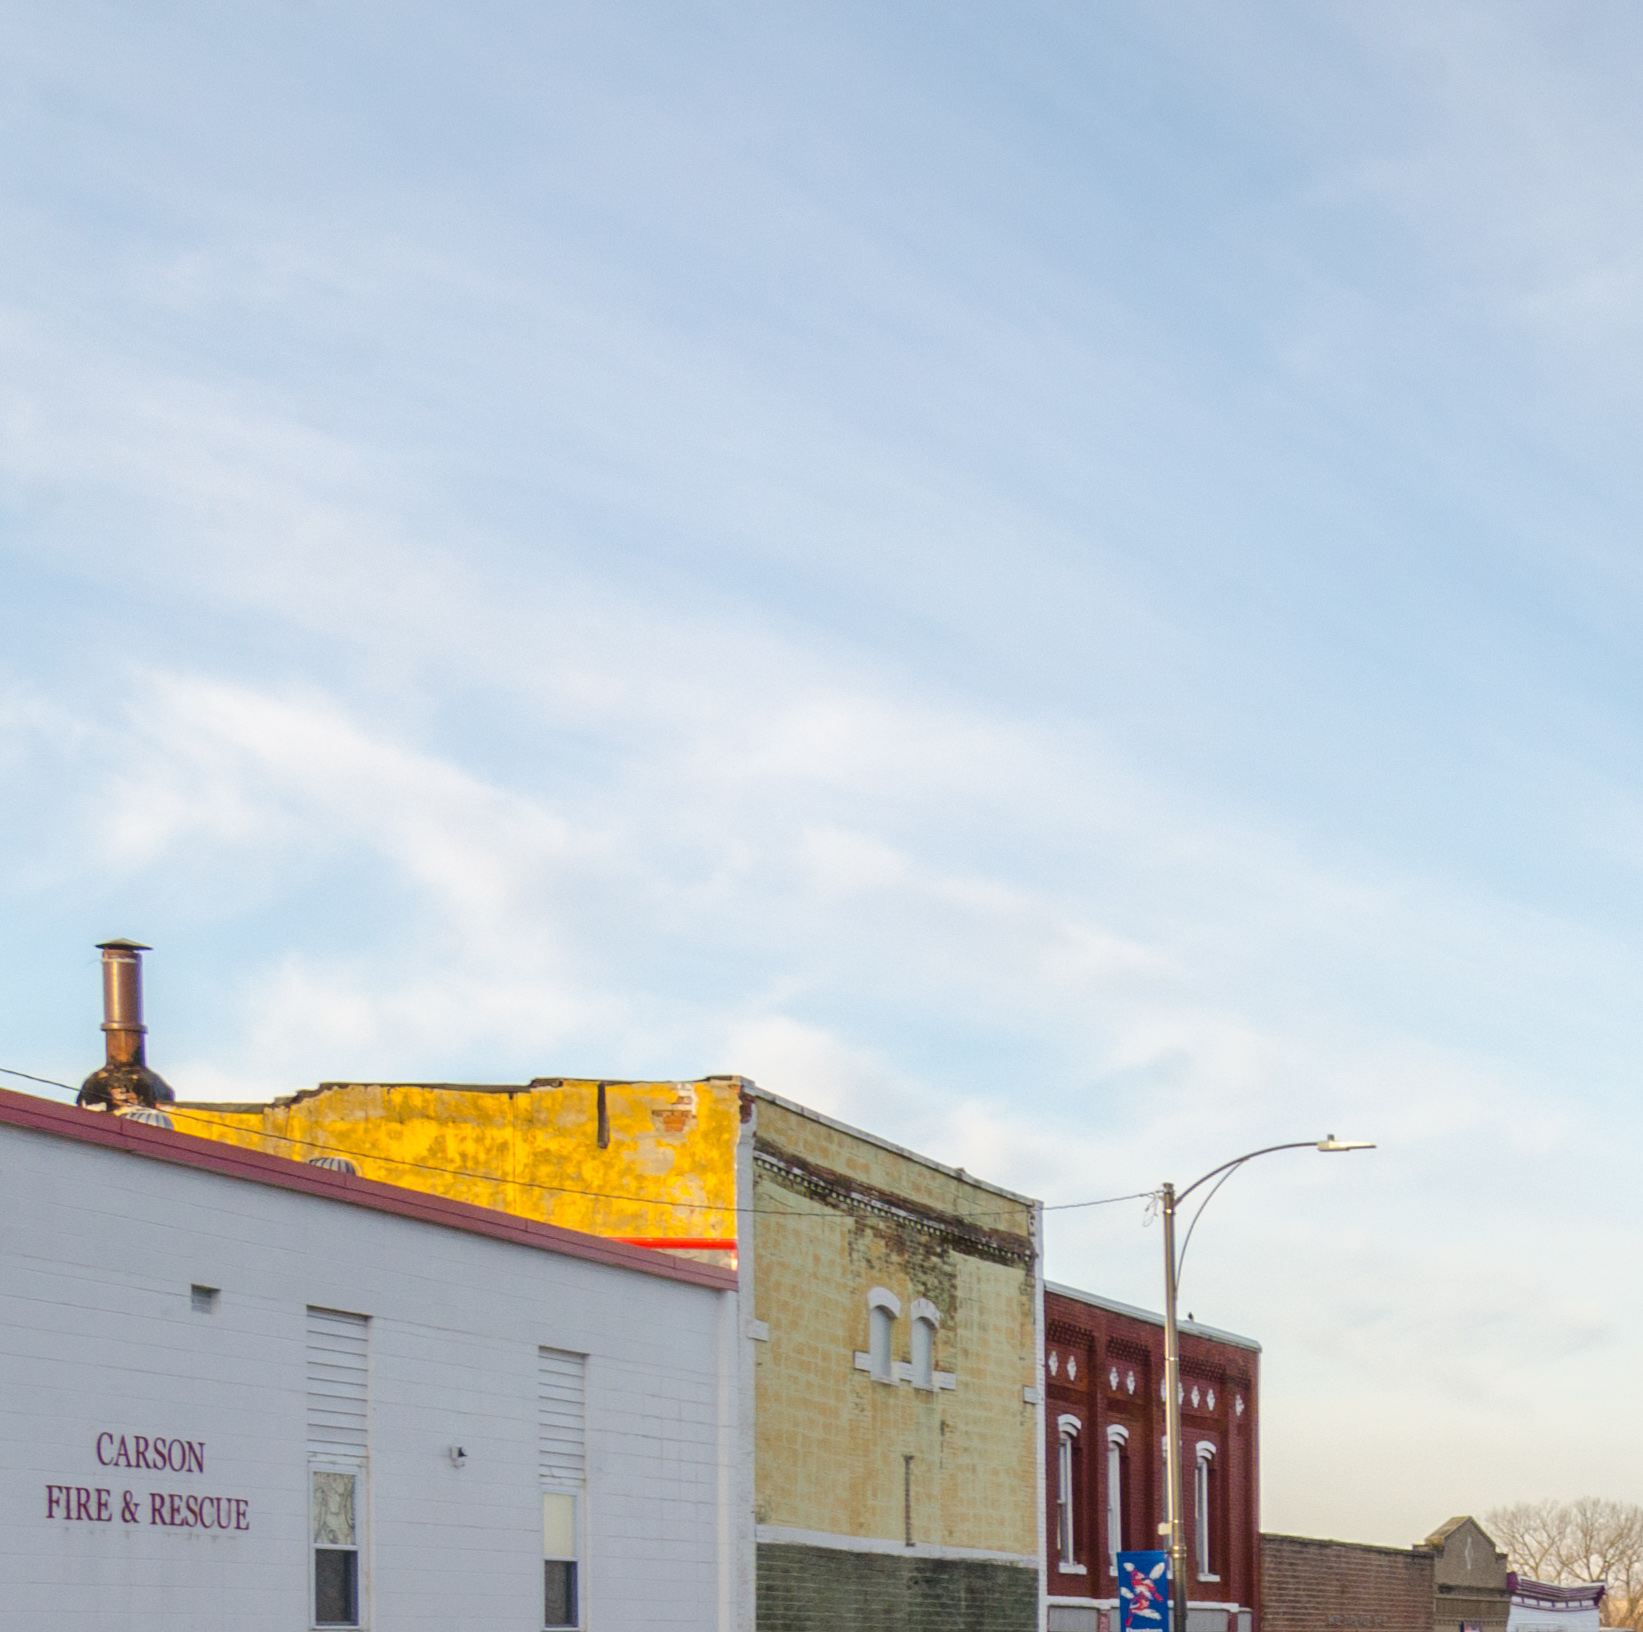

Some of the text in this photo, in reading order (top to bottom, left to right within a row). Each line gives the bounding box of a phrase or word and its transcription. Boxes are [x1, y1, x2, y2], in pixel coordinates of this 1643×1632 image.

[96, 1431, 206, 1474] CARSON
[45, 1484, 250, 1531] FIRE & RESCUE
